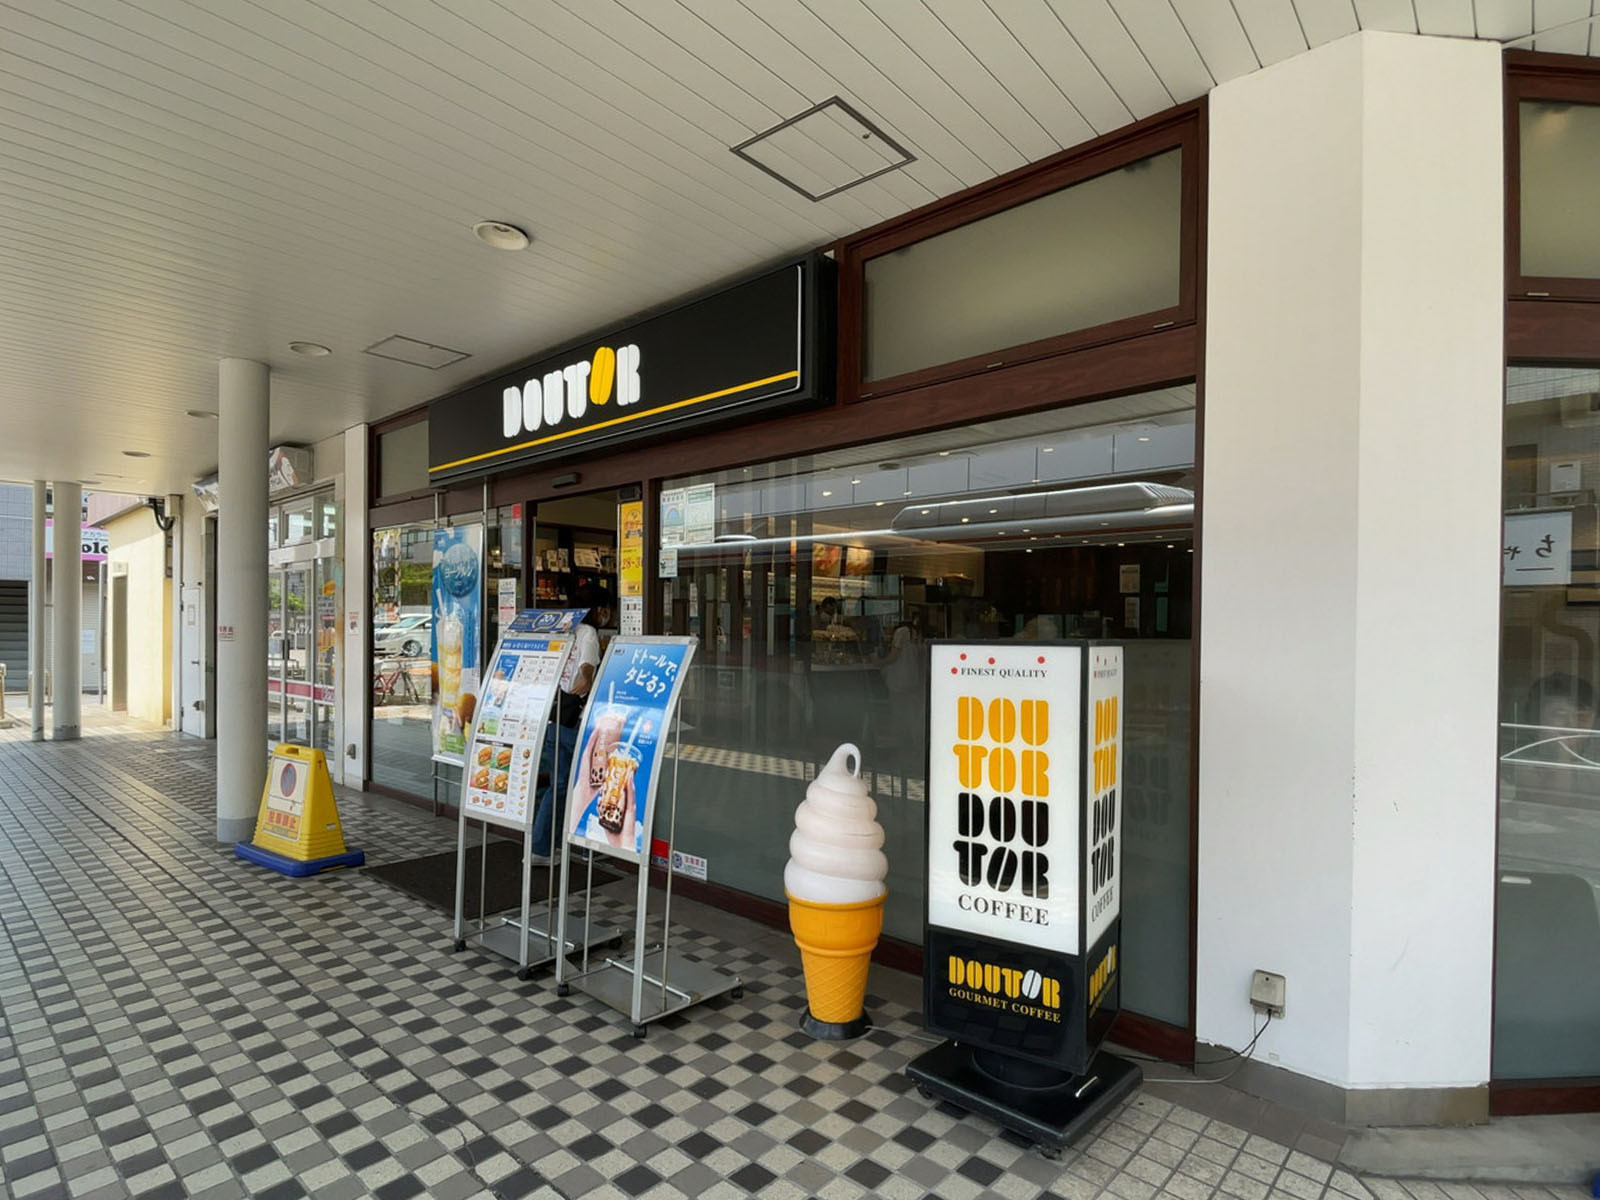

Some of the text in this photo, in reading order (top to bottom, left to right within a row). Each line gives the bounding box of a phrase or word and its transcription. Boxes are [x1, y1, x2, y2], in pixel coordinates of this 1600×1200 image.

[503, 344, 640, 437] DOUTOR
[961, 667, 1047, 678] FINEST QUALITY
[957, 696, 1049, 746] DOU
[953, 744, 1049, 797] TOR
[958, 792, 1049, 847] DOU
[953, 840, 1049, 899] TOR
[958, 894, 1049, 926] COFFEE
[949, 955, 1060, 1009] DOUTOR
[949, 987, 1061, 1023] GOURMET COFFEE
